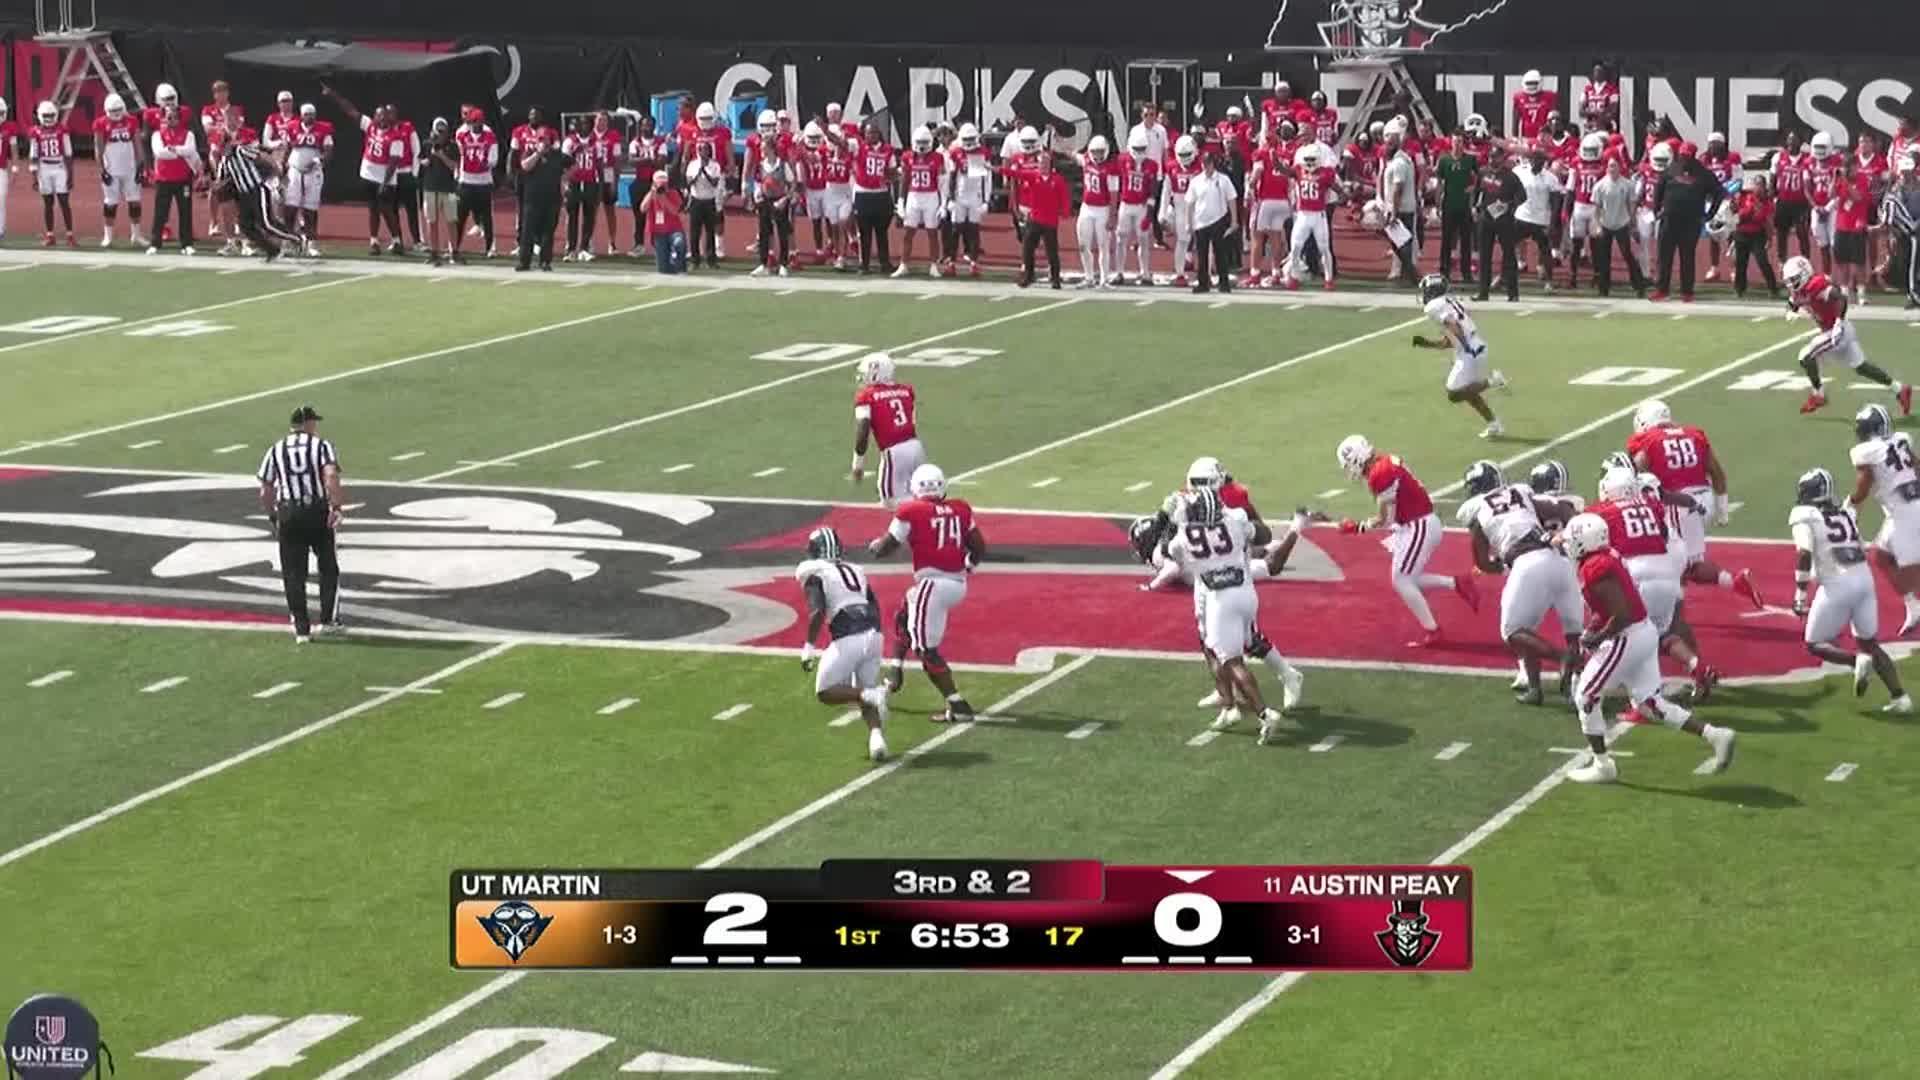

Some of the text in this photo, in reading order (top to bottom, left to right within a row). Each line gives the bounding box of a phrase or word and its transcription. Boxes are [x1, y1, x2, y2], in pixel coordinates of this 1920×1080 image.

[888, 399, 908, 426] 3
[1662, 437, 1699, 469] 58
[931, 515, 961, 550] 74
[1621, 506, 1661, 539] 62
[1824, 511, 1859, 544] 51
[1186, 524, 1233, 559] 93
[11, 1046, 89, 1062] UNITED
